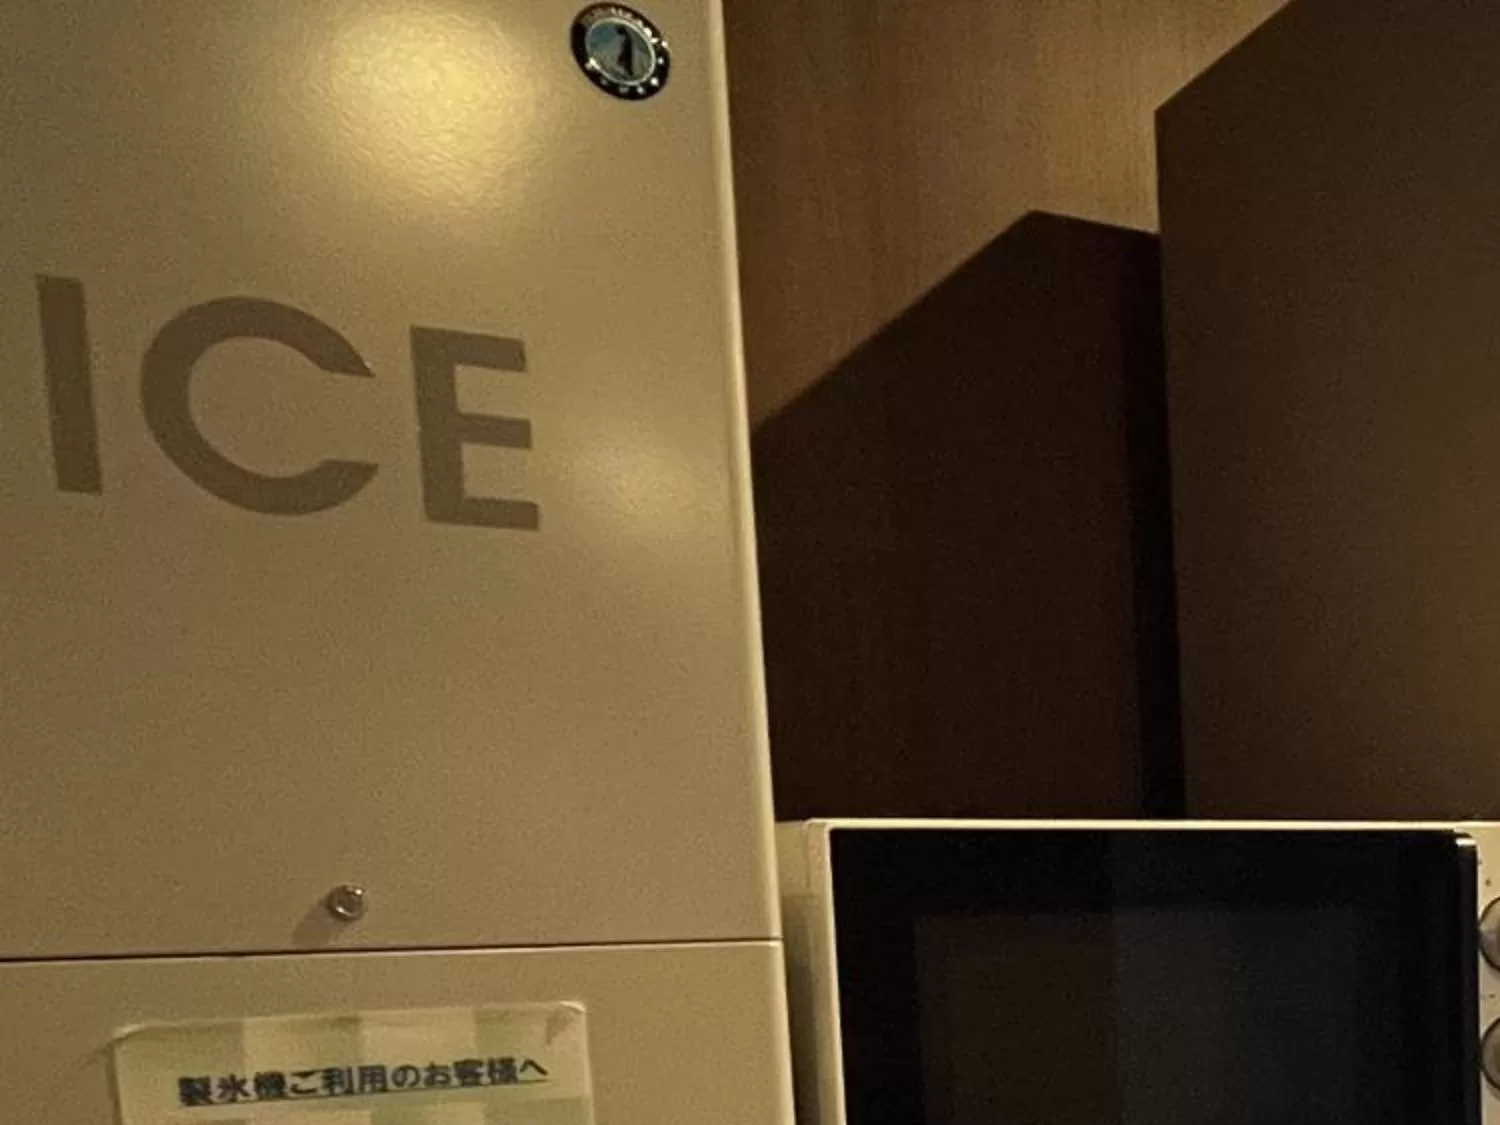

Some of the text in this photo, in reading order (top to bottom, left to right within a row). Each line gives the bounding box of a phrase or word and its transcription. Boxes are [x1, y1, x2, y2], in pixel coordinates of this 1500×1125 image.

[36, 272, 540, 532] ICE
[178, 1057, 549, 1105] 製氷機ご利用のお客様へ
